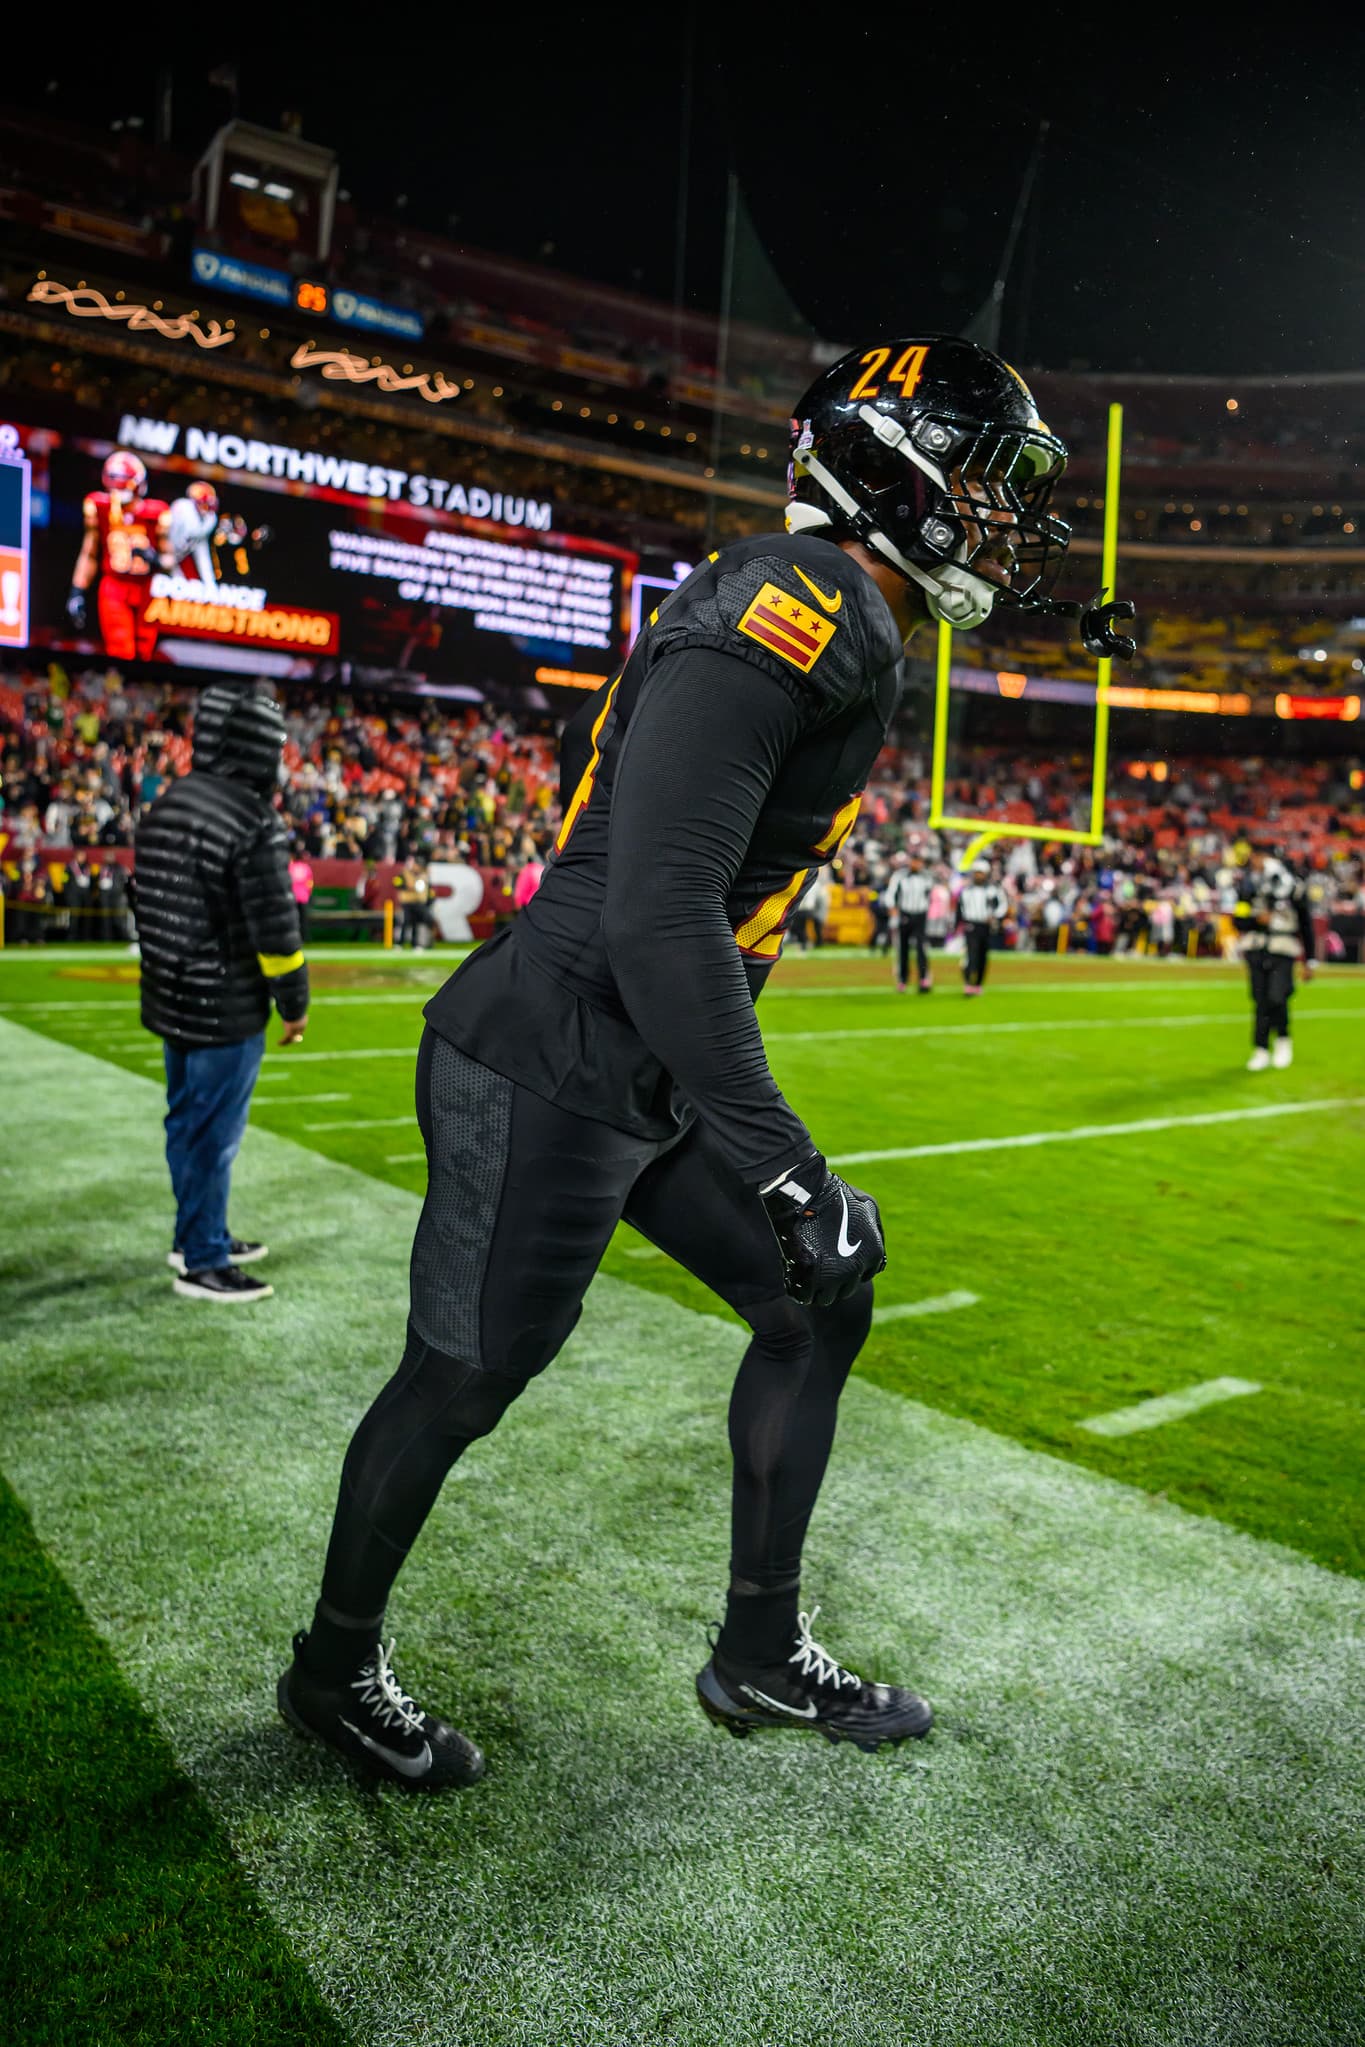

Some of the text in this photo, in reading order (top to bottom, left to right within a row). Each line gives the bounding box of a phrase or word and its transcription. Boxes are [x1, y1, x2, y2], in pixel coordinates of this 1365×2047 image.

[848, 345, 930, 401] 24
[186, 427, 408, 500] NORTHWEST
[409, 474, 552, 531] STADIUM
[144, 597, 331, 646] ARMSTRONG
